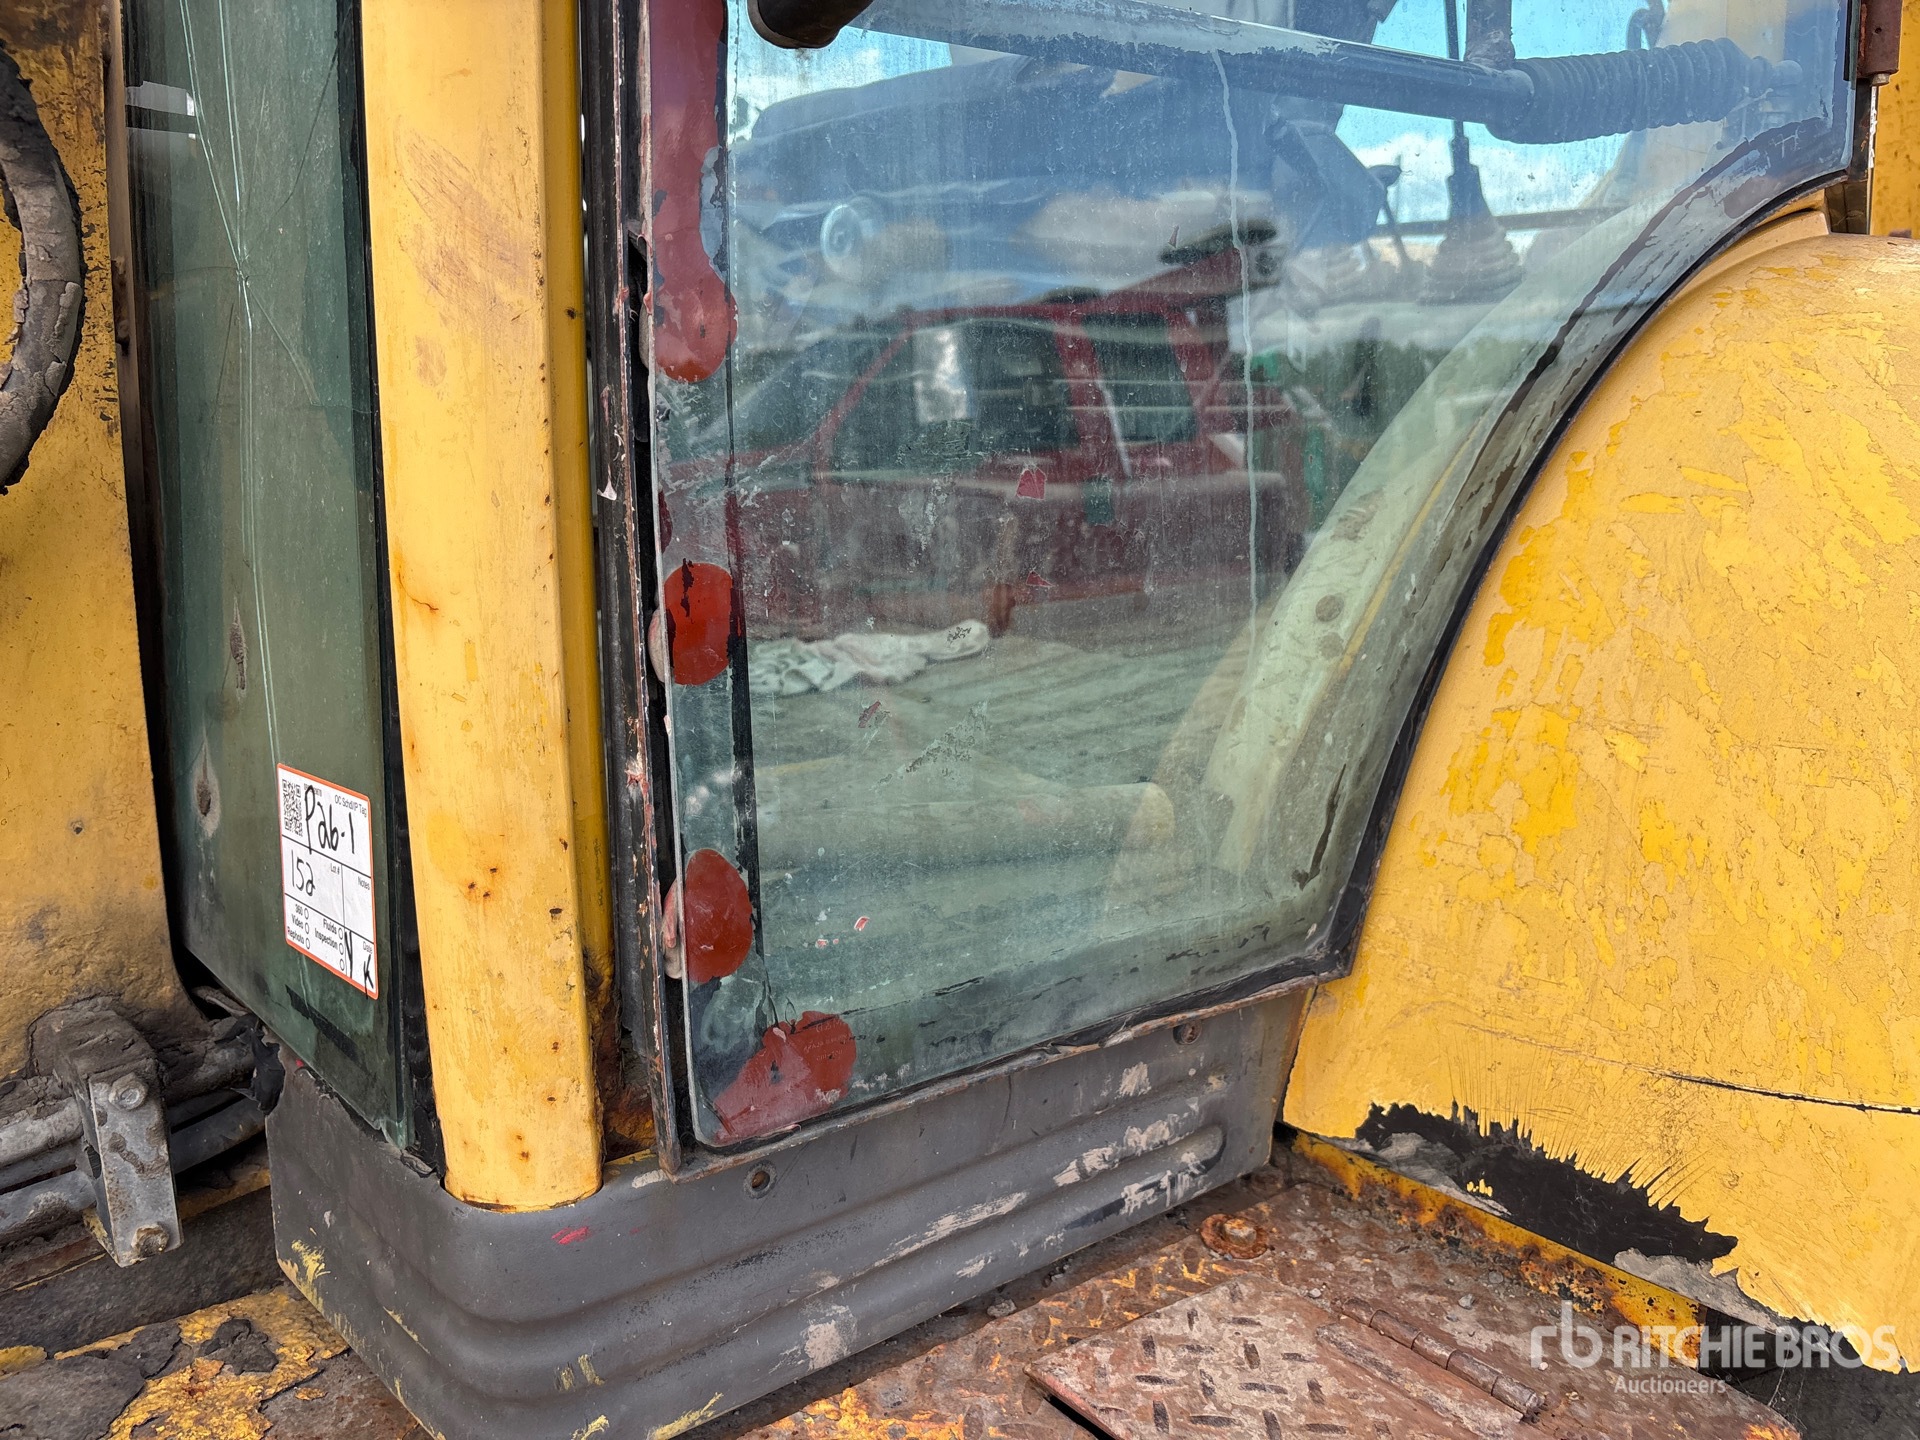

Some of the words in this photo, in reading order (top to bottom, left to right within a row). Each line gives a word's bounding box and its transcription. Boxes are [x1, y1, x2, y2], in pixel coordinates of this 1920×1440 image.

[357, 876, 371, 891] Notes
[291, 914, 304, 929] Video
[323, 918, 337, 935] Fluids
[314, 927, 338, 950] Inspection
[363, 941, 373, 954] Date
